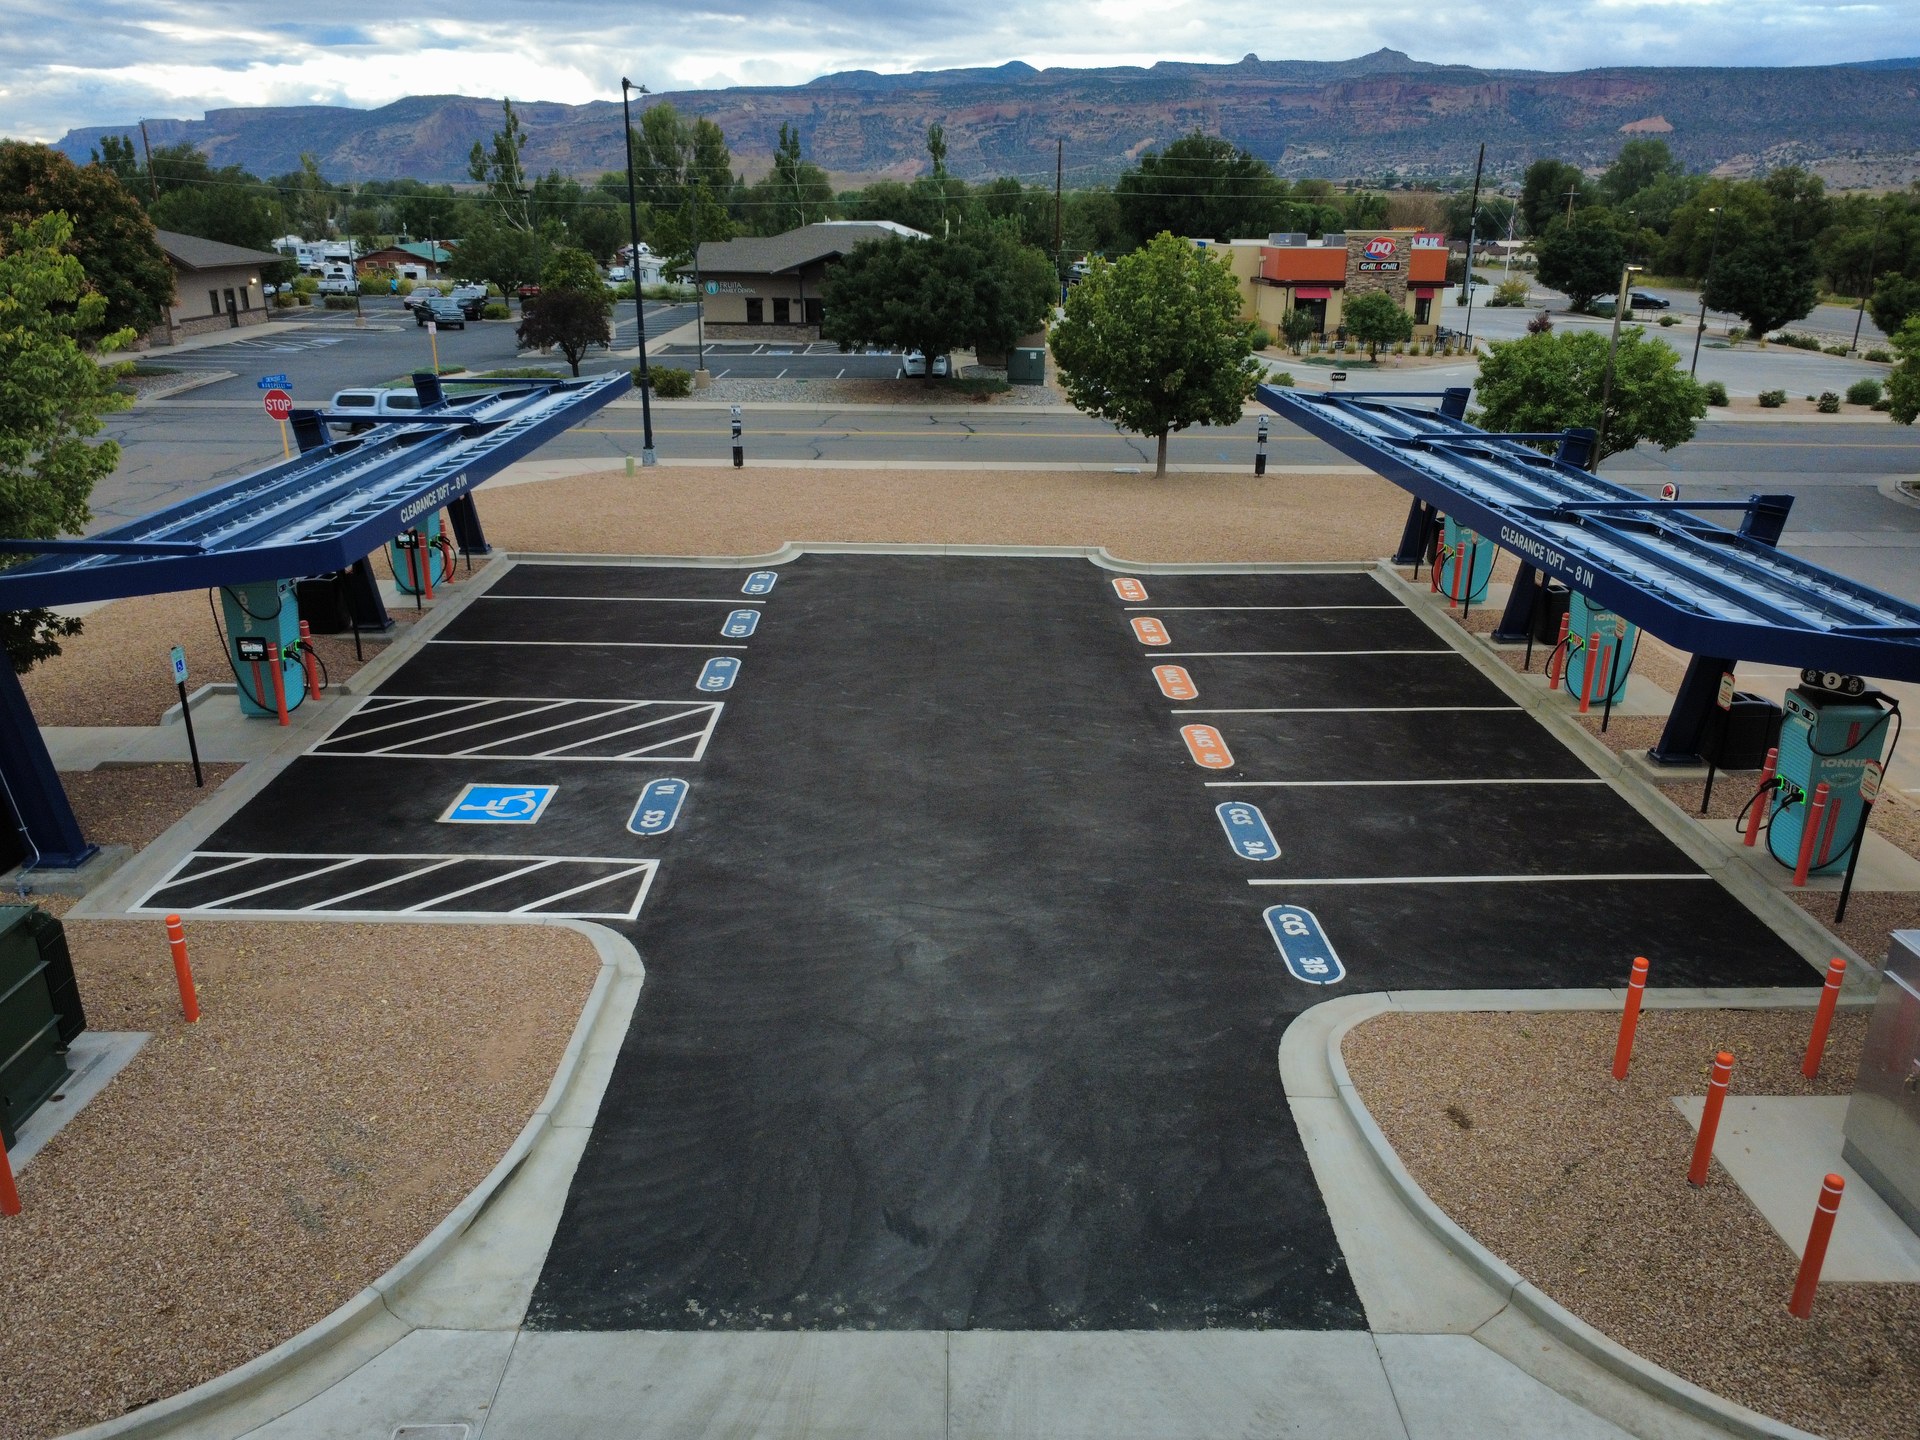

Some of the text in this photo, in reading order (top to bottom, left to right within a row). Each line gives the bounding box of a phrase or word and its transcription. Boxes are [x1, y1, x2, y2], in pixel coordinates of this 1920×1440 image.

[1371, 242, 1392, 255] DQ
[1361, 263, 1376, 271] Grill
[1381, 263, 1398, 271] Chill
[720, 281, 743, 289] FRUITA
[266, 399, 291, 411] STOP
[400, 491, 437, 523] CLEARANCE
[436, 483, 450, 502] 10FT
[455, 477, 461, 490] 8
[460, 473, 468, 488] IN
[1500, 525, 1545, 561] CLEARANCE
[1546, 548, 1567, 571] 10FT
[1575, 566, 1584, 582] 8
[1583, 570, 1594, 589] IN
[750, 584, 765, 592] CCS
[730, 625, 747, 634] CCS
[1139, 620, 1158, 633] NACS
[707, 676, 726, 687] CCS
[1162, 669, 1189, 695] NACS 4A
[1828, 676, 1836, 686] 3
[1191, 729, 1223, 763] NACS 4B
[640, 784, 678, 828] CCS 1A
[1228, 808, 1268, 856] CCS 3A
[1278, 913, 1329, 974] CCS 3B
